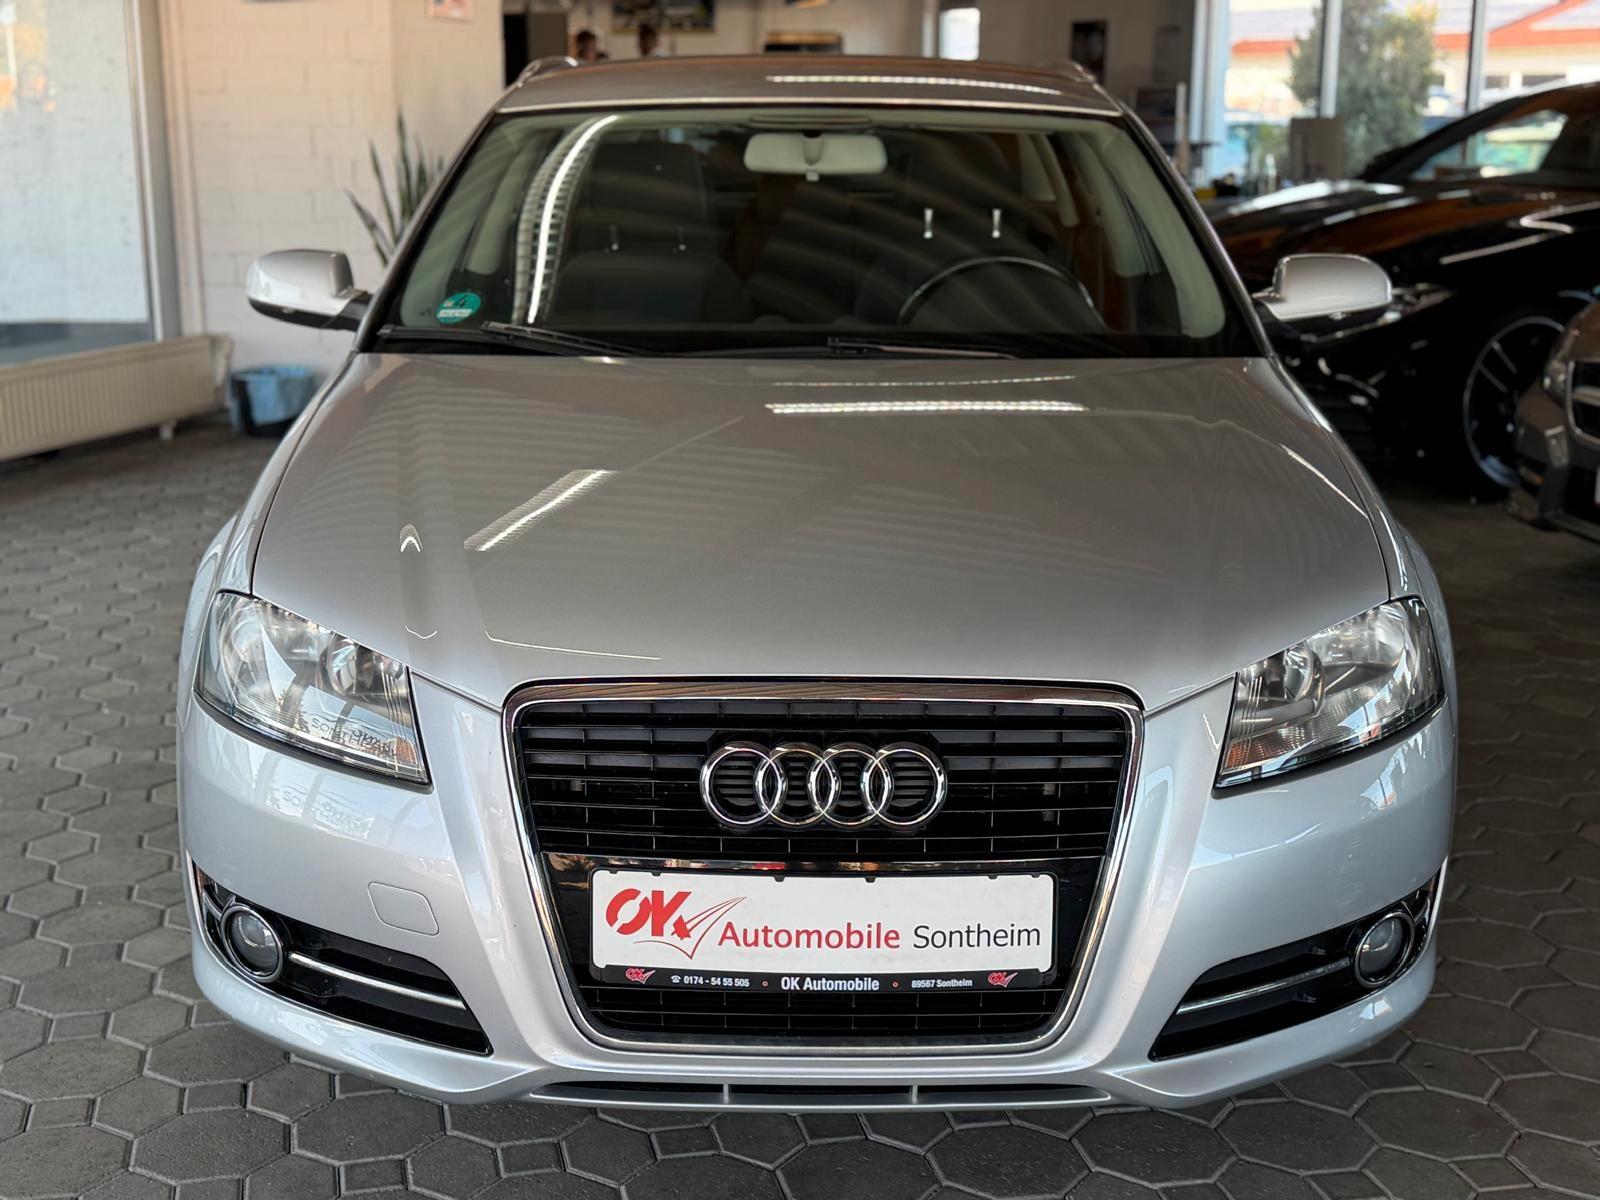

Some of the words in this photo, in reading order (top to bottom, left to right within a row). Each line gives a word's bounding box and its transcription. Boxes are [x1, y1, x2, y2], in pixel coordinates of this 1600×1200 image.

[606, 888, 692, 940] OK
[718, 921, 901, 949] Automobile
[913, 923, 1041, 949] Sontheim
[683, 975, 704, 986] 0174
[711, 977, 722, 986] 54
[722, 977, 734, 987] 55
[734, 978, 750, 988] 505
[780, 976, 800, 990] OK
[803, 976, 880, 991] Automobile
[936, 977, 973, 988] Sontheim
